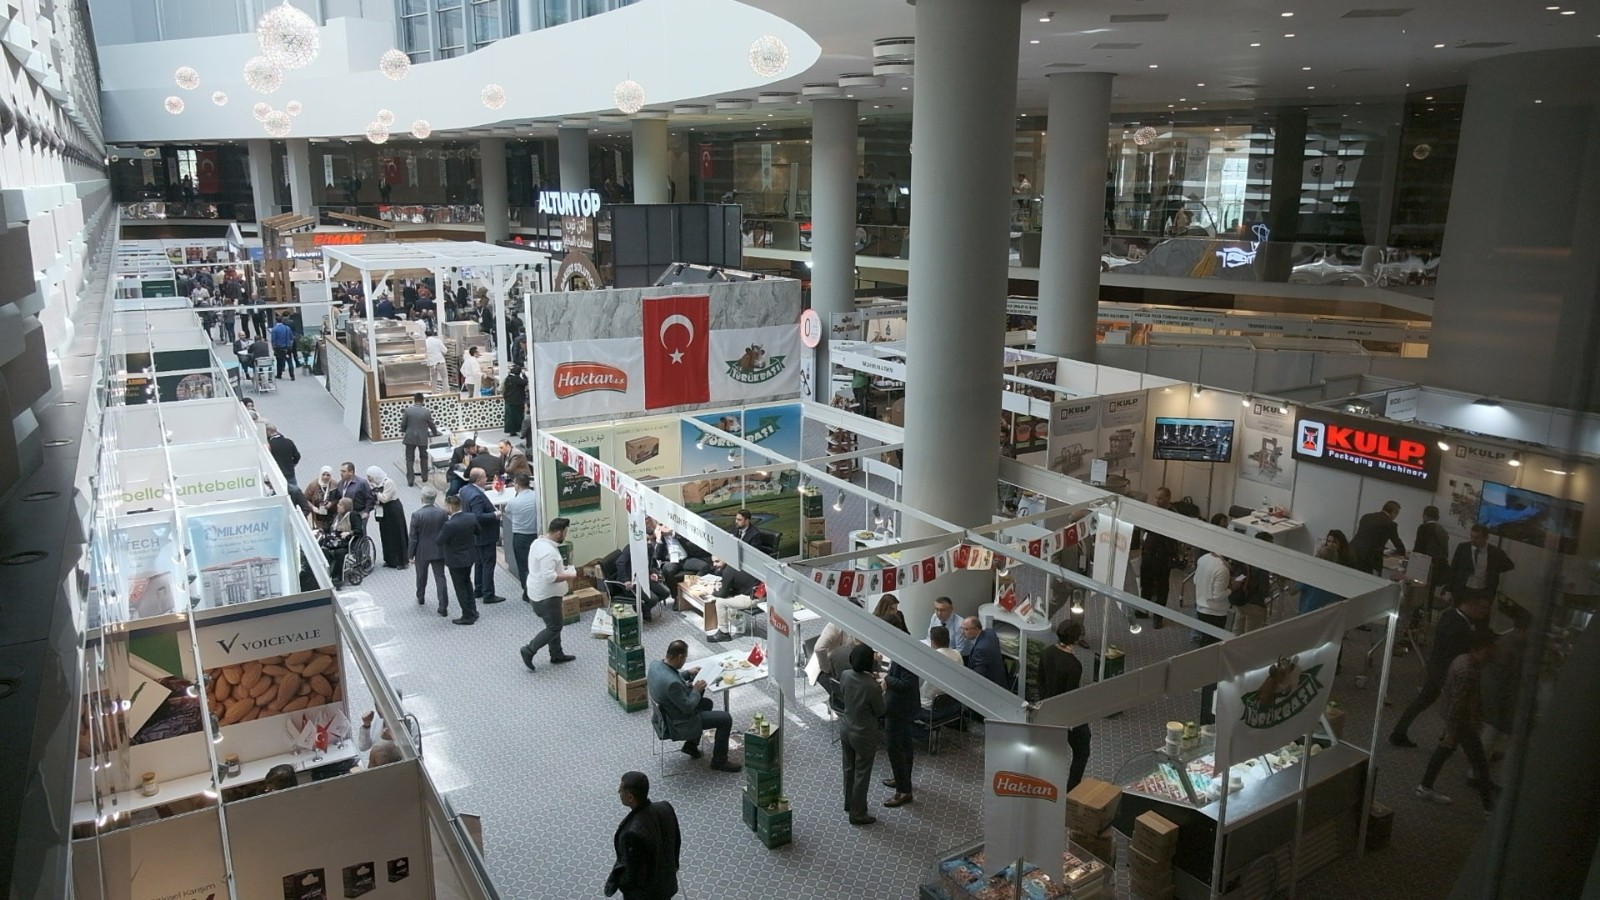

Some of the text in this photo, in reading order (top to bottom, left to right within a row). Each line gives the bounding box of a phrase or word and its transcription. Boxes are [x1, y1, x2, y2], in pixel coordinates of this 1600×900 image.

[539, 191, 601, 217] ALTUNTOP
[558, 371, 613, 388] Haktan
[1069, 405, 1091, 414] KULP
[1117, 398, 1138, 407] KULP
[1263, 405, 1289, 415] KUL
[704, 425, 775, 447] YÖRBAŞI
[1326, 425, 1427, 462] KULP
[1468, 446, 1507, 460] KULP
[1328, 449, 1428, 479] Packaging Machinery
[217, 521, 269, 537] MILKMAN
[241, 629, 321, 651] VOICEVALE
[996, 777, 1053, 796] Haktan
